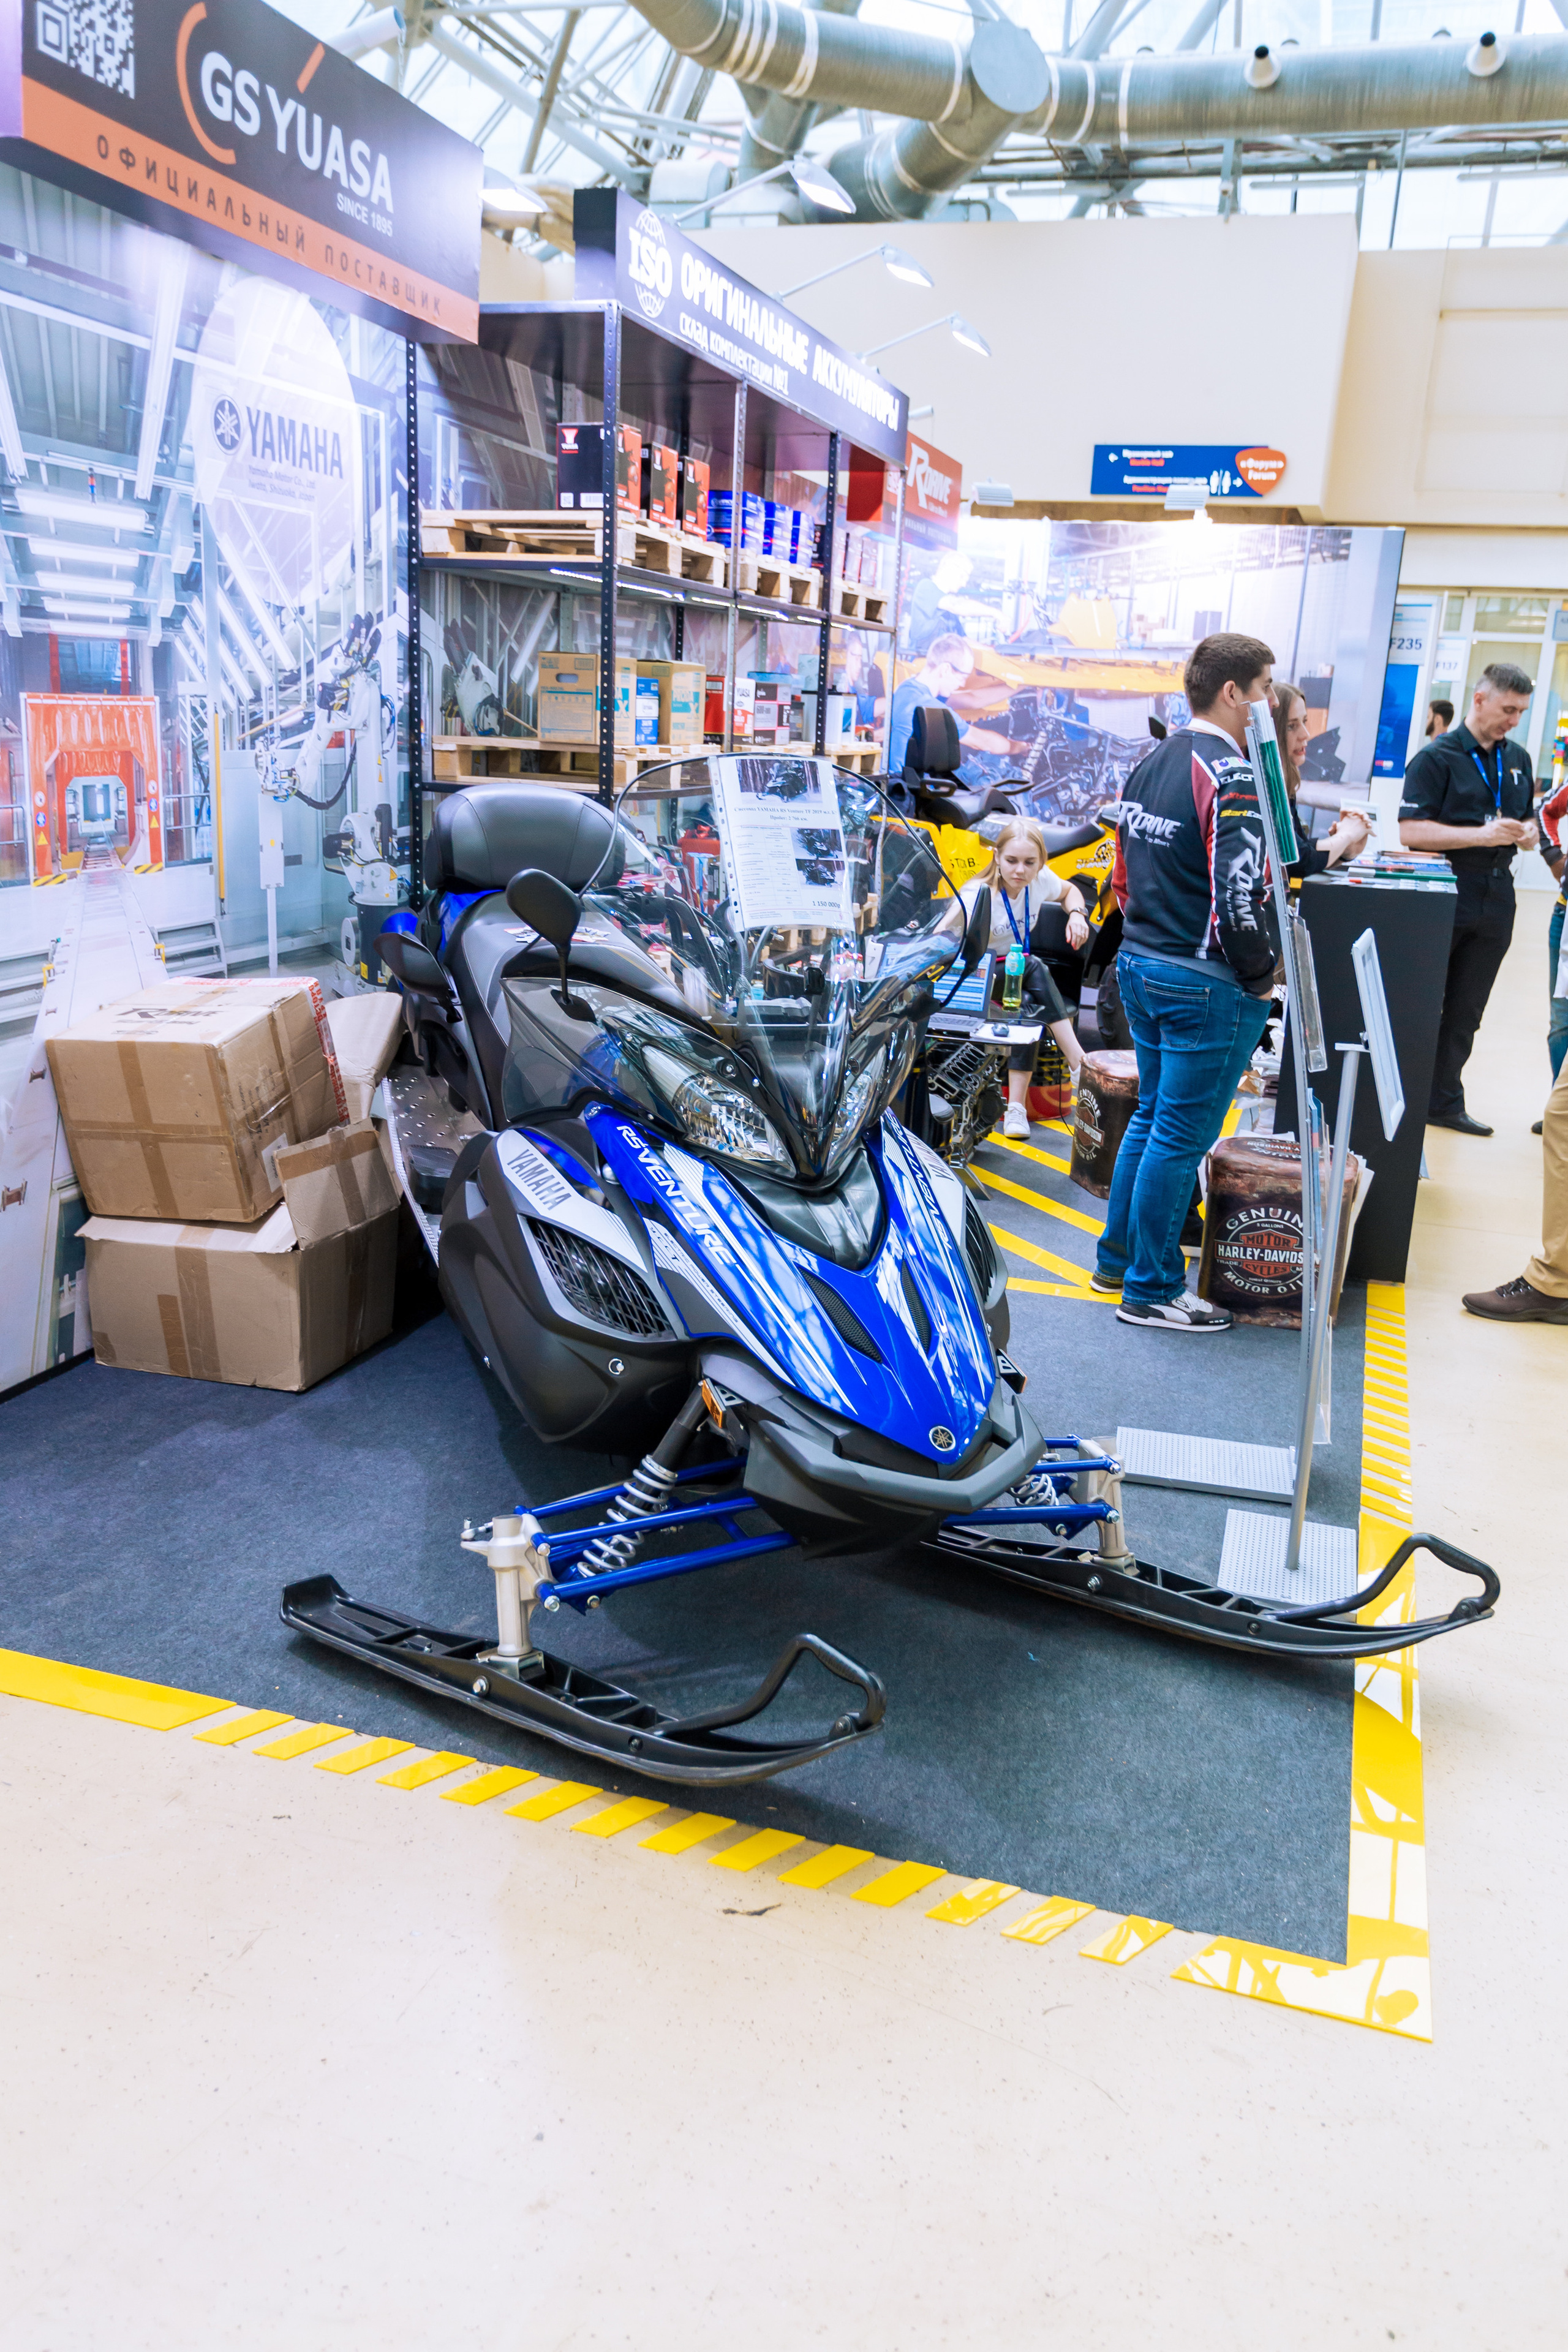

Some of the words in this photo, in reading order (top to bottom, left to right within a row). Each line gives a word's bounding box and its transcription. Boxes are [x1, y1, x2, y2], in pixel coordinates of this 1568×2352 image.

[201, 51, 261, 137] GS
[265, 83, 395, 214] YUASA
[97, 134, 306, 253] ОФИЦИАЛЬНЫЙ
[324, 244, 442, 317] ПОСТАВЩИК
[336, 192, 369, 226] SINCE
[371, 213, 393, 238] 1895
[628, 227, 673, 298] ISO
[681, 252, 809, 374] ОРИГИНАЛЬНЫЕ
[246, 406, 343, 479] YAMAHA
[1390, 638, 1422, 650] F235
[1436, 662, 1458, 670] F137
[1079, 1088, 1101, 1118] ENUINE
[507, 1149, 571, 1211] YAMAHA
[885, 1110, 940, 1216] VENTURE
[636, 1145, 739, 1265] VENTURE
[1226, 1207, 1303, 1230] GENUIN
[1218, 1244, 1321, 1265] HARLEY-DAVIDSN
[1246, 1233, 1291, 1246] MOTOR
[664, 1232, 690, 1264] ELECTRIC
[690, 1264, 710, 1287] POWER
[710, 1289, 739, 1323] STEERING
[1223, 1271, 1270, 1294] MOTOR
[1245, 1264, 1288, 1275] CYCLES
